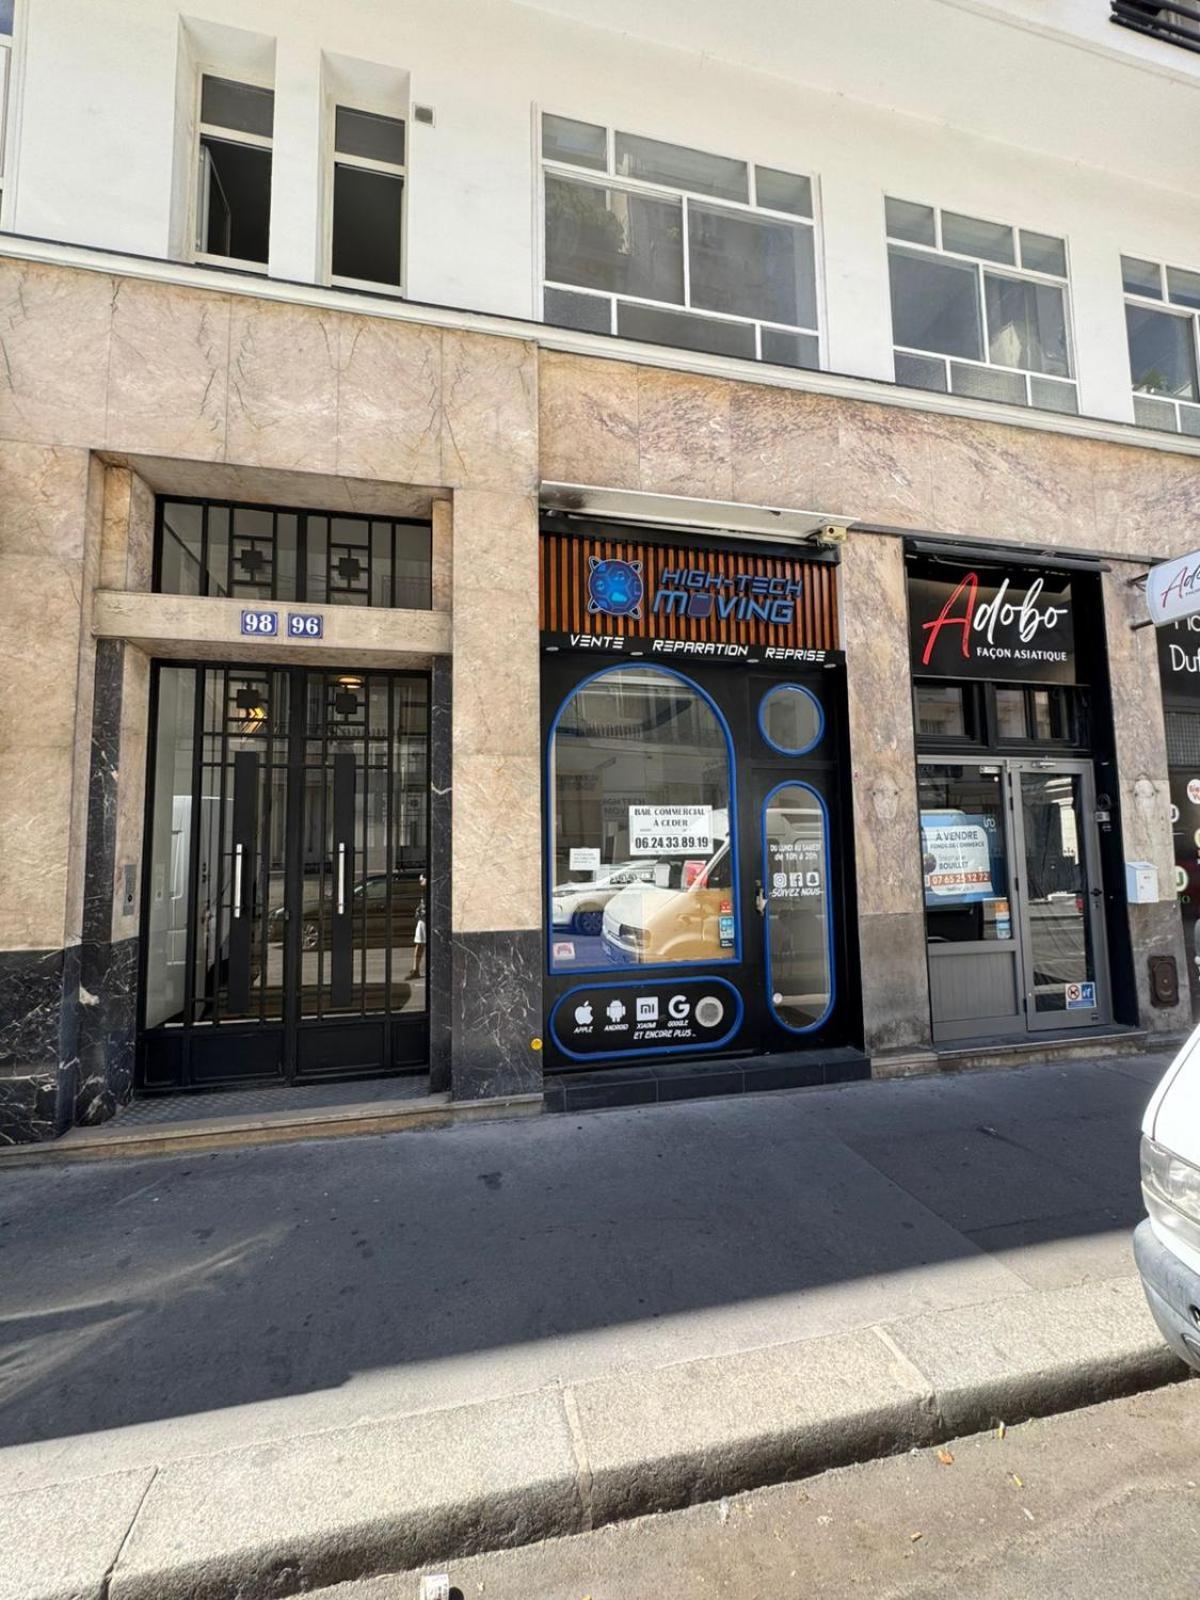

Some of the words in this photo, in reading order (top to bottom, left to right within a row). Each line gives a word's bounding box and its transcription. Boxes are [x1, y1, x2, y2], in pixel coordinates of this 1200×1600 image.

[662, 568, 803, 600] HIGH-TECH
[245, 613, 273, 632] 98
[921, 571, 1068, 666] Adobo
[291, 616, 319, 635] 96
[570, 634, 625, 650] VENTE
[652, 640, 749, 657] REPARATION
[765, 647, 826, 662] REPRISE
[976, 646, 1011, 660] FAÇON
[1014, 649, 1068, 662] ASIATIQUE
[634, 807, 652, 816] BAIL
[654, 807, 705, 816] COMMERCIAL
[943, 830, 978, 841] VENDRE
[635, 836, 709, 849] 06.24.33.89.19
[573, 1025, 593, 1034] APPLE
[604, 1023, 629, 1032] ANDROID
[667, 1019, 689, 1028] GOOGLE
[633, 1031, 644, 1040] ET
[644, 1029, 673, 1039] ENCORE
